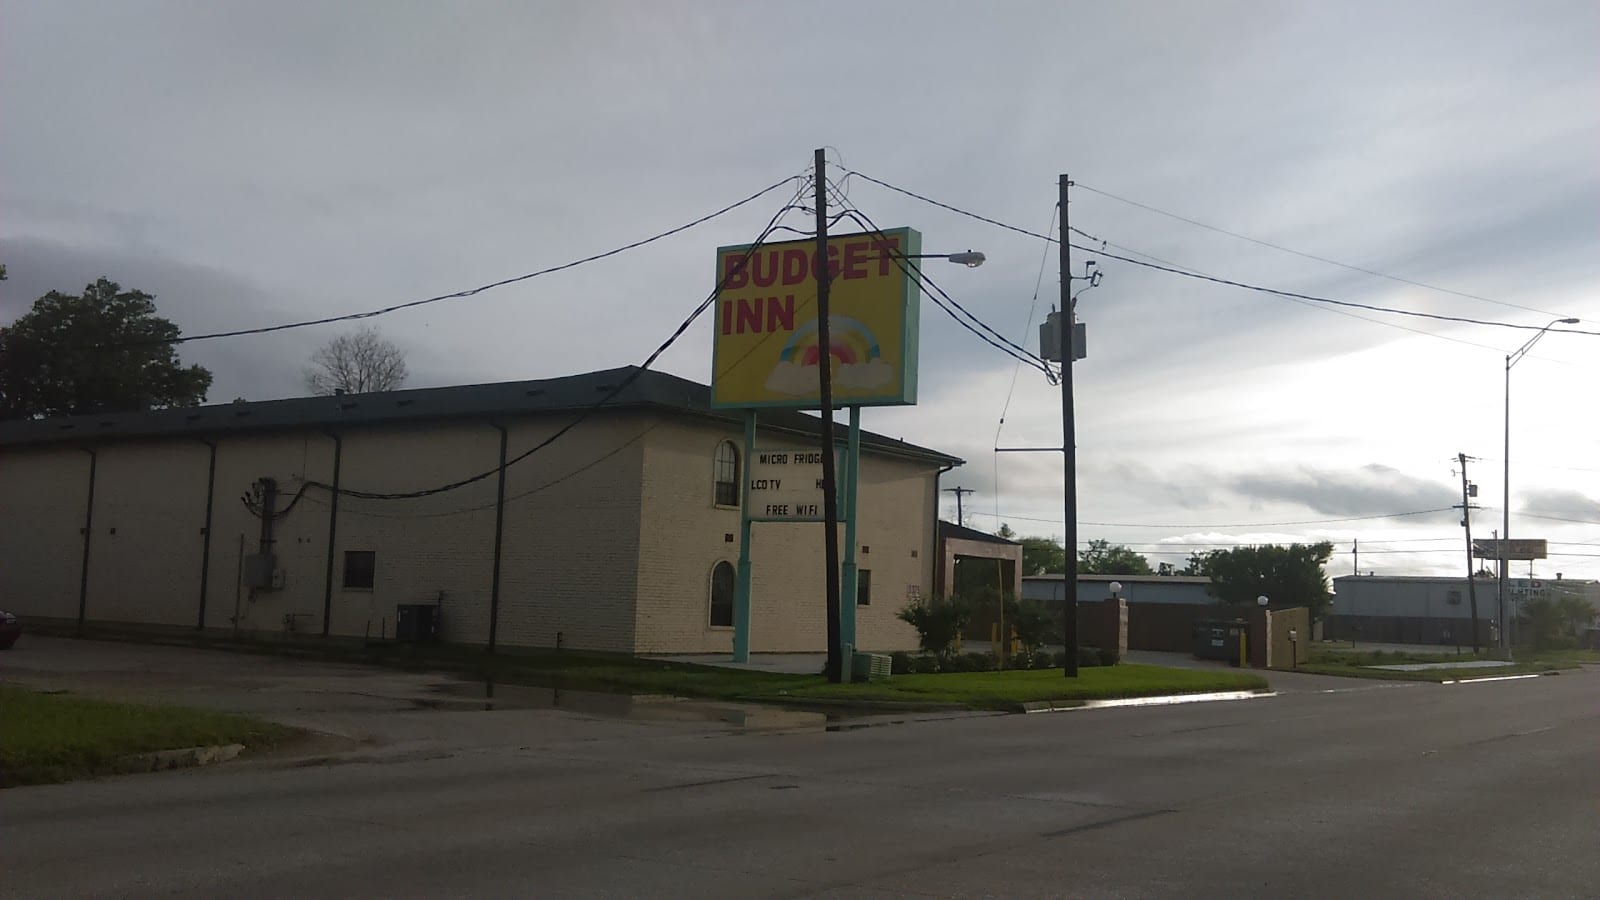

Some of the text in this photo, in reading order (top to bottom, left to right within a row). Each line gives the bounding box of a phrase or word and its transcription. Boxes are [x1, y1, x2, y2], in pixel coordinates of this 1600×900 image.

[724, 239, 899, 290] BUDGET
[722, 295, 795, 336] INN
[759, 453, 823, 465] MICRO FRIDG
[766, 505, 789, 516] FREE
